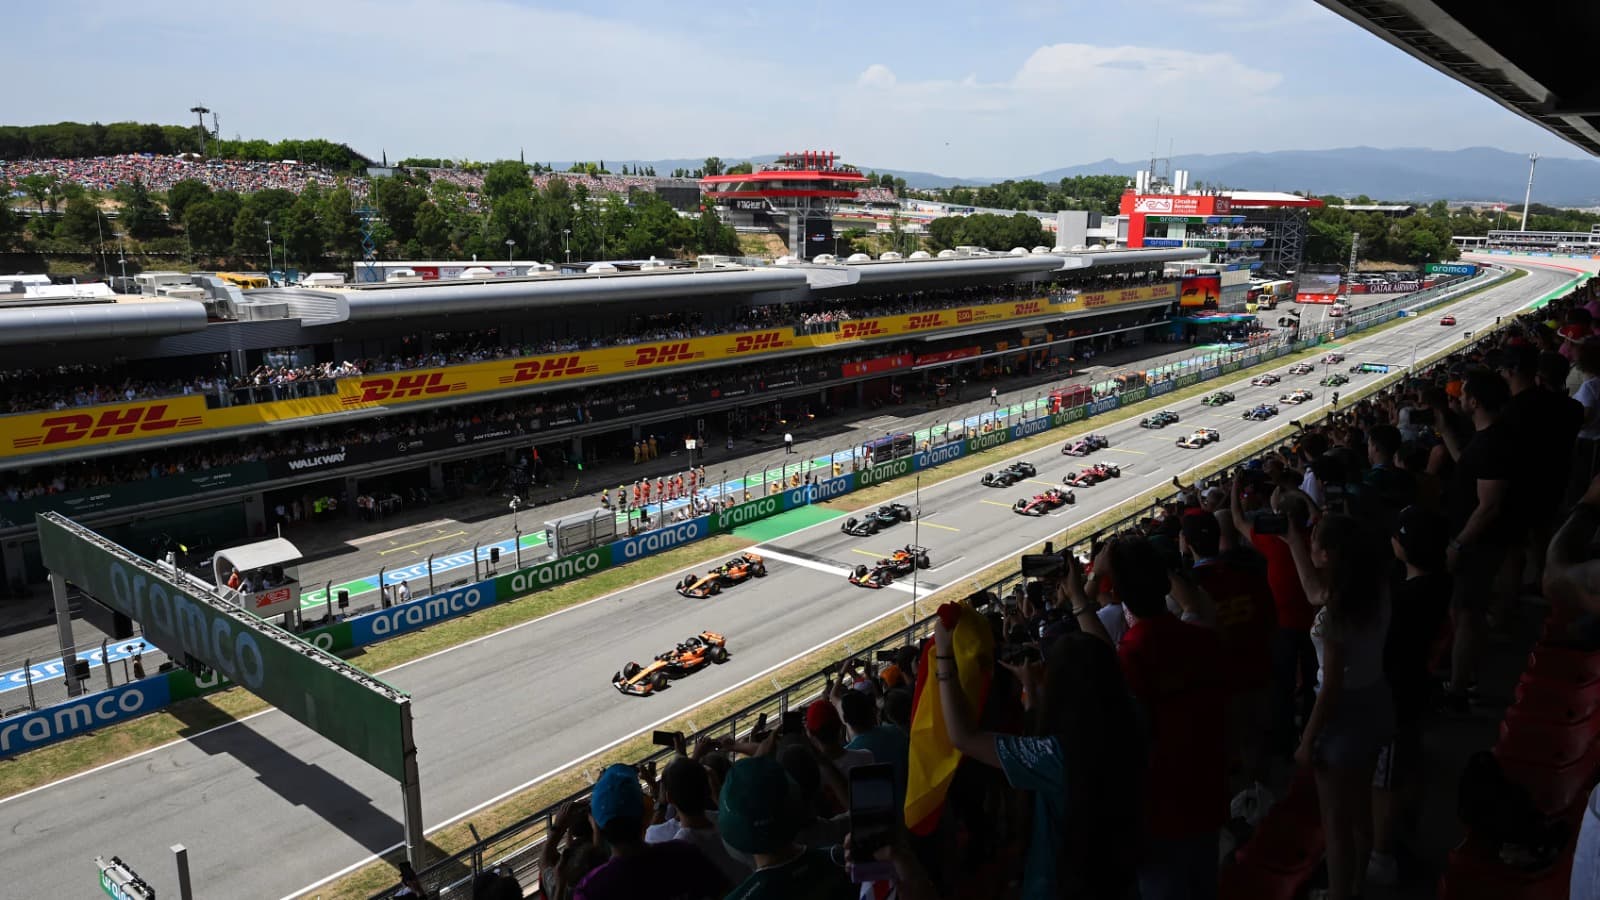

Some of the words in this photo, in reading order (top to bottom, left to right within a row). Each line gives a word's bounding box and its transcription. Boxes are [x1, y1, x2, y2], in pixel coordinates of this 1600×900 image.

[1159, 216, 1189, 224] aramco
[1431, 265, 1468, 274] aramco
[1370, 284, 1392, 293] QATAR
[1393, 282, 1419, 293] AIRWAYS
[1015, 302, 1042, 316] DHL
[842, 320, 881, 339] DHL
[908, 313, 942, 329] DHL
[736, 332, 785, 353] DHL
[636, 343, 696, 366] DHL
[514, 356, 586, 382] DHL
[360, 373, 451, 402] DHL
[1122, 389, 1146, 404] aramco
[1055, 407, 1083, 424] aramco
[1090, 398, 1116, 414] aramco
[41, 405, 181, 445] DHL
[1015, 418, 1047, 437] aramco
[970, 431, 1007, 451] aramco
[288, 450, 347, 471] WALKWAY
[919, 445, 960, 467] aramco
[860, 460, 907, 485] aramco
[792, 477, 846, 504] aramco
[718, 498, 776, 528] aramco
[624, 523, 698, 558] aramco
[511, 552, 600, 593] aramco
[371, 588, 481, 635] aramco
[110, 562, 265, 690] aramco
[0, 688, 145, 751] ramco
